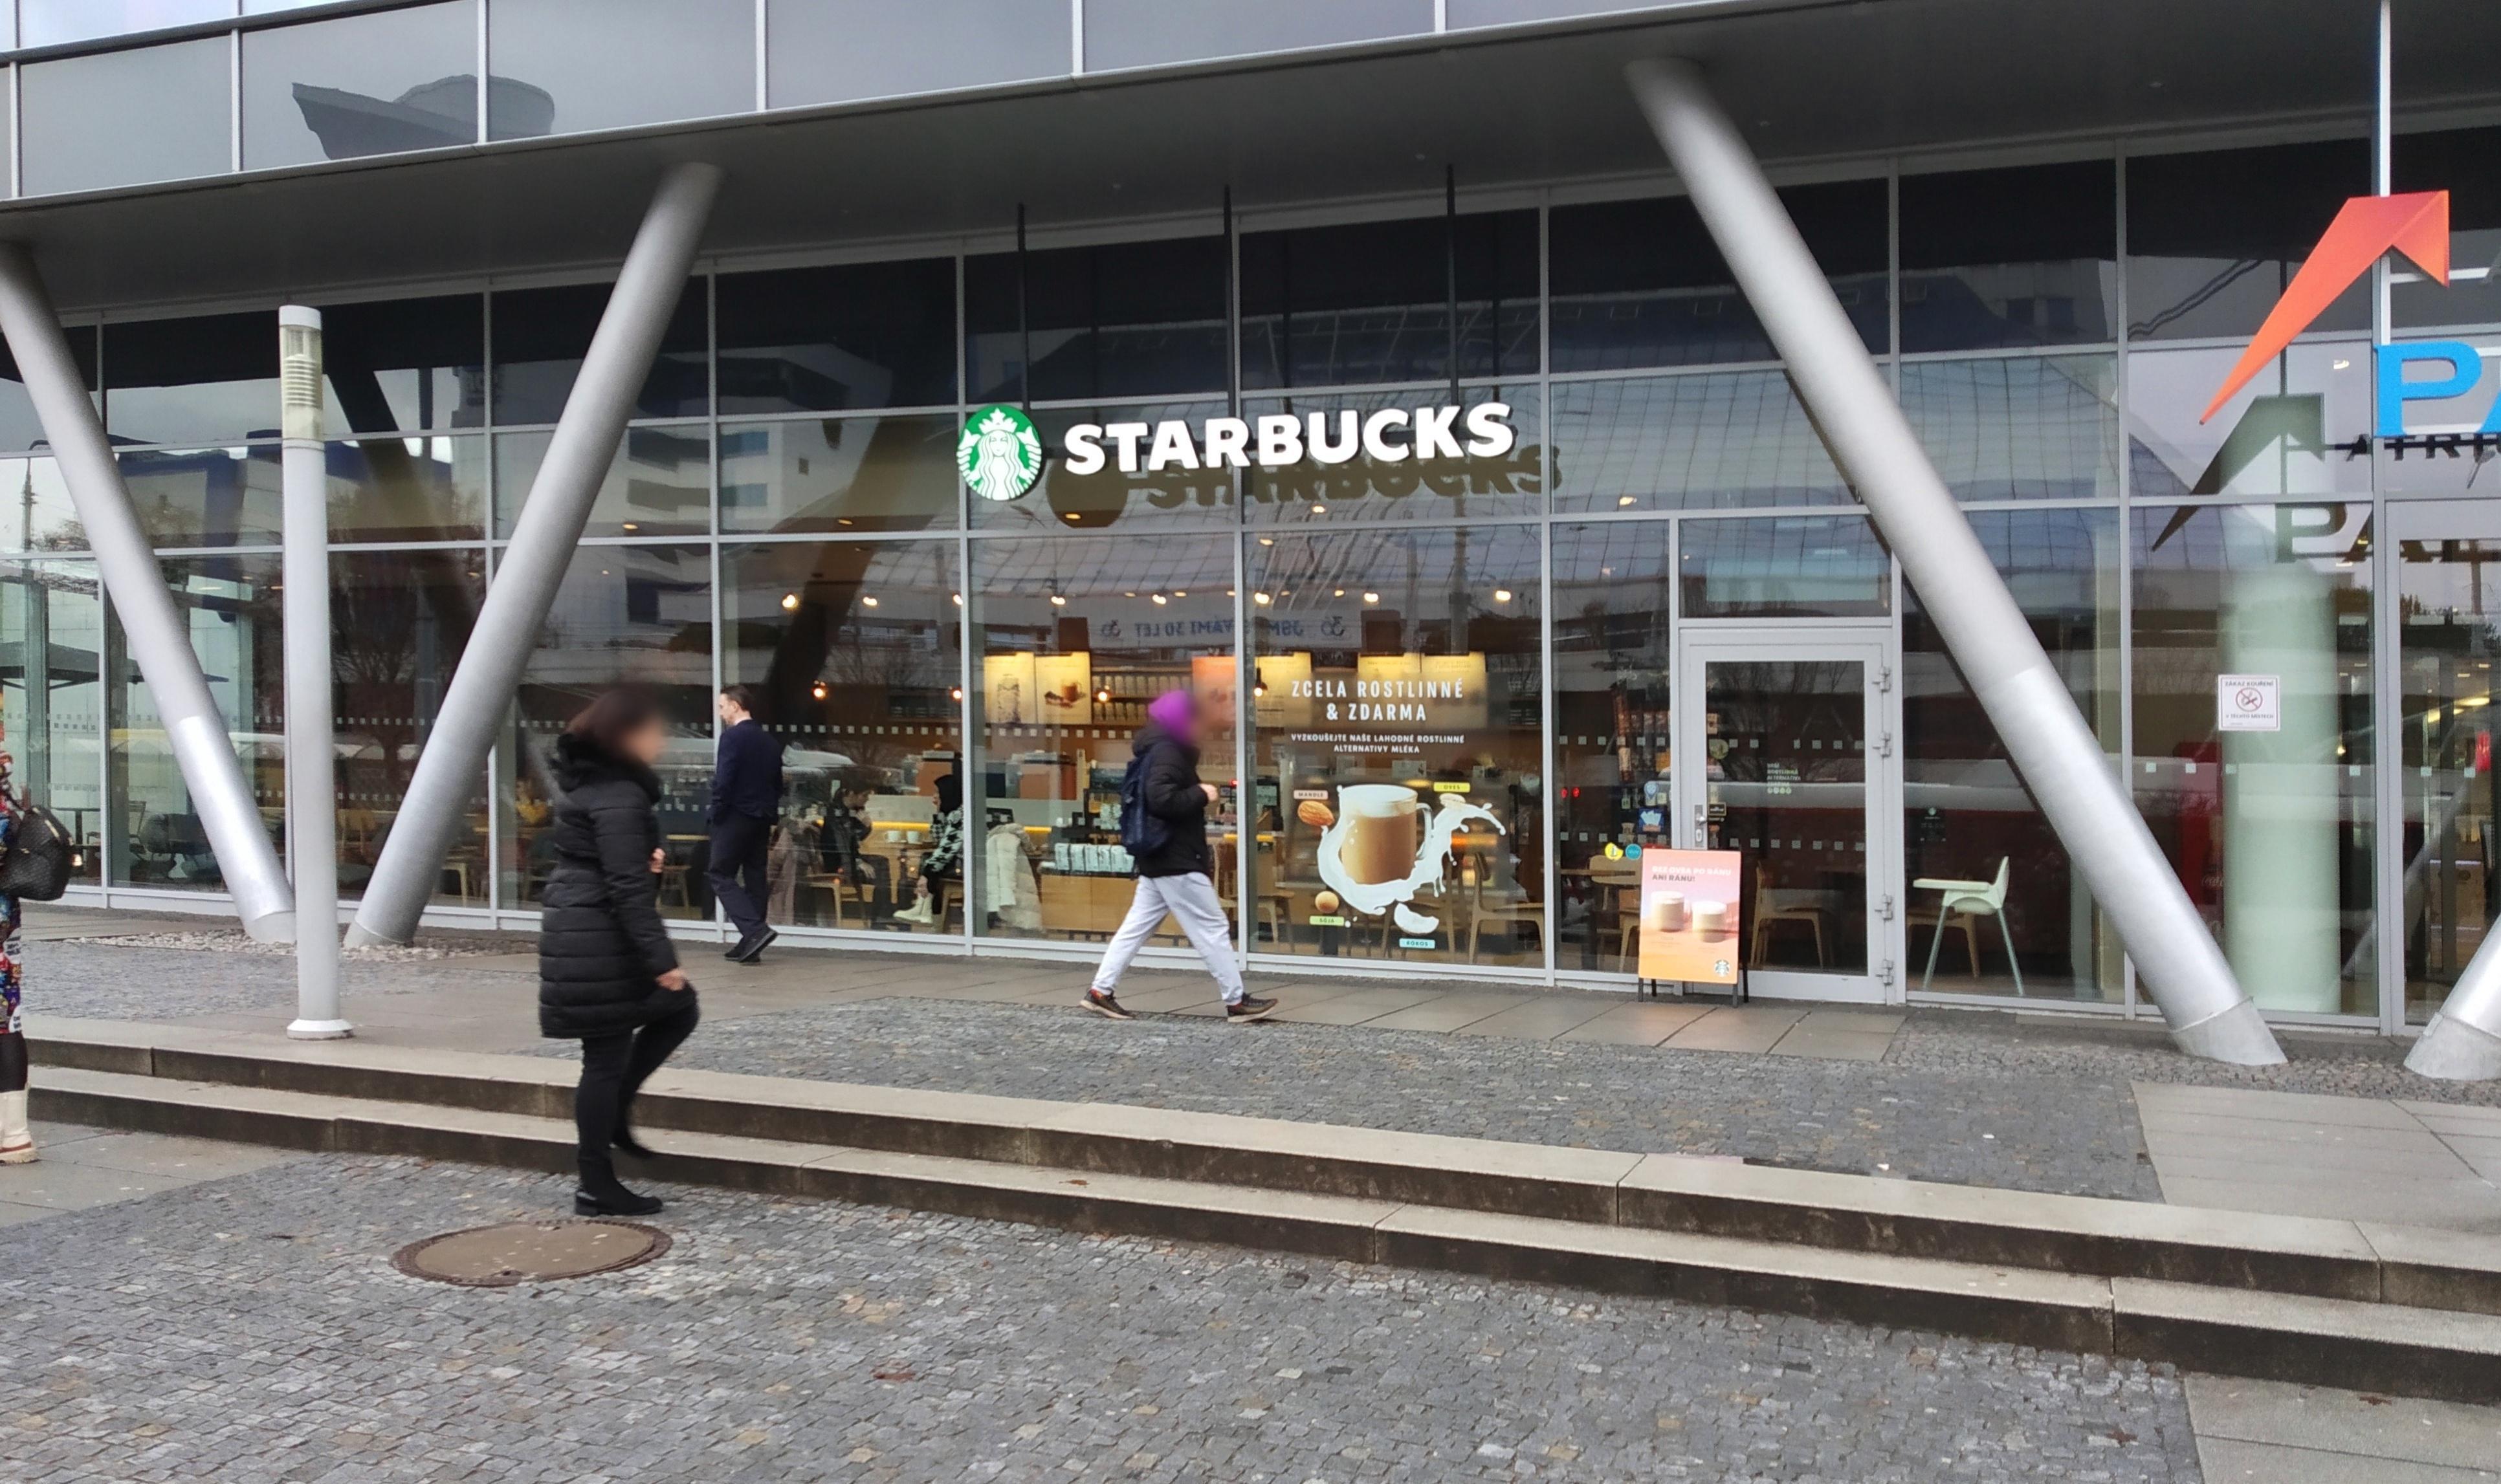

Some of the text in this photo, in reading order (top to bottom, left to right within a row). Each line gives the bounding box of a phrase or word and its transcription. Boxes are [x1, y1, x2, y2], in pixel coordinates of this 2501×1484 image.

[1063, 402, 1515, 475] STARBUCKS
[1292, 678, 1464, 698] ZCELA ROSTLINNÉ
[1327, 703, 1426, 721] & ZDARMA
[1291, 733, 1464, 744] VYZKOUŠEJTE NAŠE LAHODNÉ ROSTLINNÉ
[1334, 745, 1420, 754] ALTERNATIVY MLÉKA
